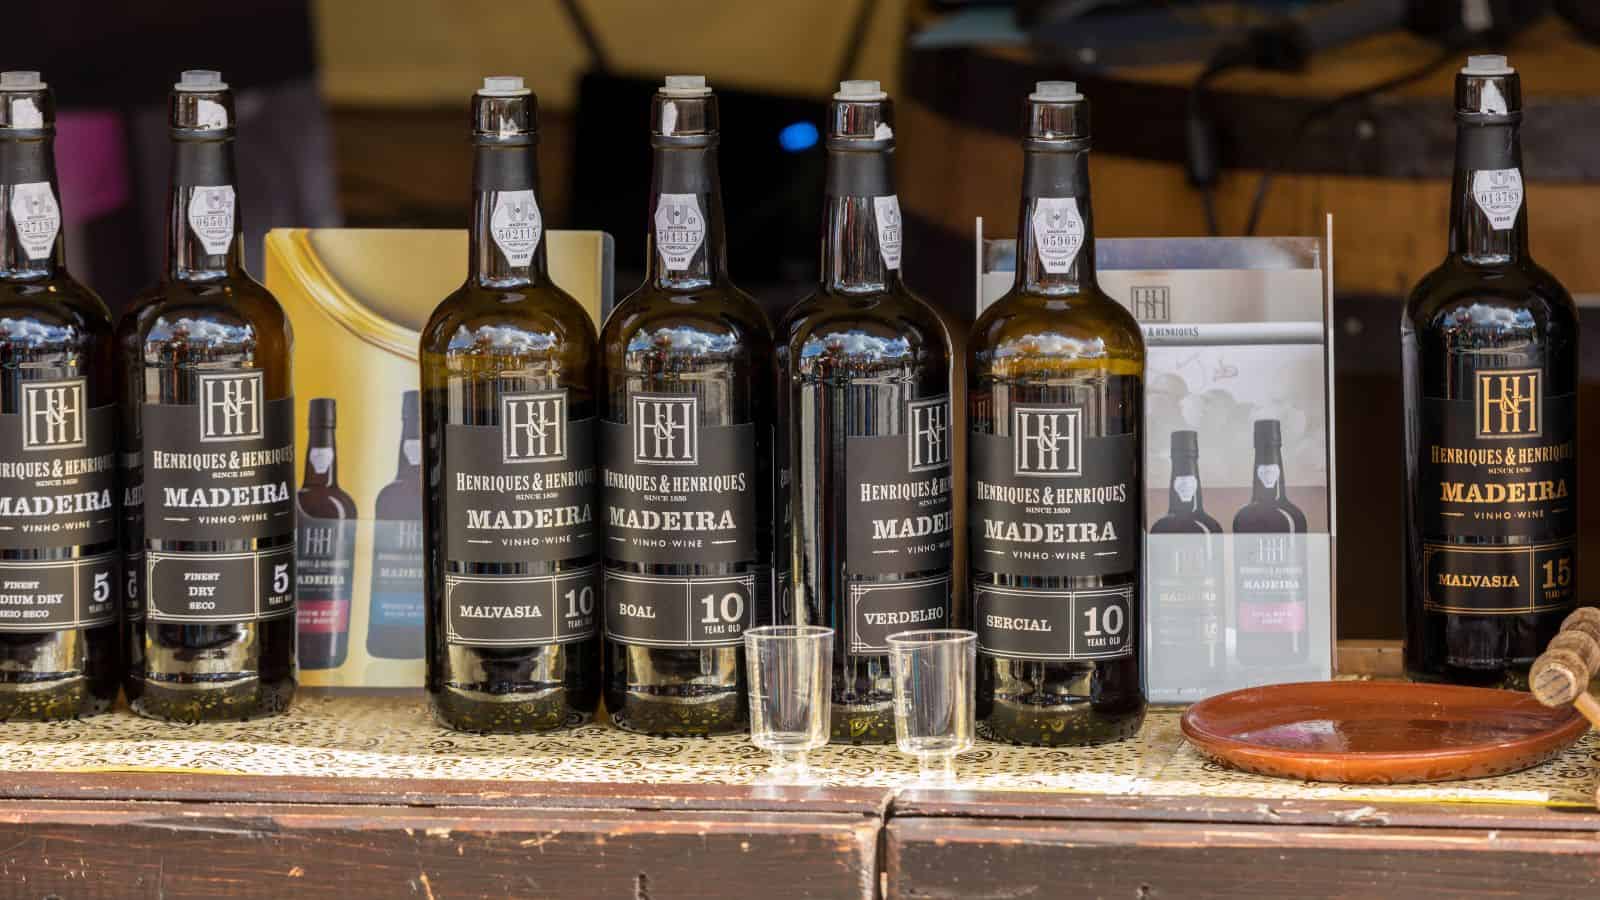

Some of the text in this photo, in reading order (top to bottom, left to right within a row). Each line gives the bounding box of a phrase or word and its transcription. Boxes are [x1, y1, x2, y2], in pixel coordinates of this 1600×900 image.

[152, 450, 226, 472] HENRIQUES
[228, 450, 241, 470] &
[1431, 445, 1502, 467] HENRIQUES
[1505, 446, 1516, 466] &
[51, 458, 63, 478] &
[456, 472, 530, 492] HENRIQUES
[532, 472, 543, 491] &
[659, 474, 671, 493] &
[673, 472, 746, 493] HENRIQUES
[860, 480, 930, 502] HENRIQUES
[930, 477, 938, 497] &
[977, 480, 1040, 504] HENRIQUES
[1042, 486, 1055, 505] &
[1056, 483, 1126, 504] HENRIQUES
[1440, 479, 1568, 503] MADEIRA
[163, 481, 289, 508] MADEIRA
[466, 503, 592, 530] MADEIRA
[609, 505, 737, 531] MADEIRA
[984, 519, 1118, 543] MADEIRA
[273, 563, 289, 594] 5
[1439, 573, 1520, 588] MALVASIA
[1542, 557, 1570, 589] 15
[94, 571, 110, 603] 5
[188, 586, 216, 597] DRY
[0, 594, 64, 605] DIUM DRY
[189, 601, 215, 610] SECO
[565, 585, 593, 619] 10
[619, 602, 656, 619] BOAL
[701, 592, 744, 623] 10
[460, 605, 542, 618] MALVASIA
[863, 606, 944, 625] VERDELHO
[1084, 604, 1124, 637] 10
[704, 623, 741, 634] YEARS OLD
[986, 614, 1052, 632] SERCIAL
[1087, 637, 1106, 647] YEARS
